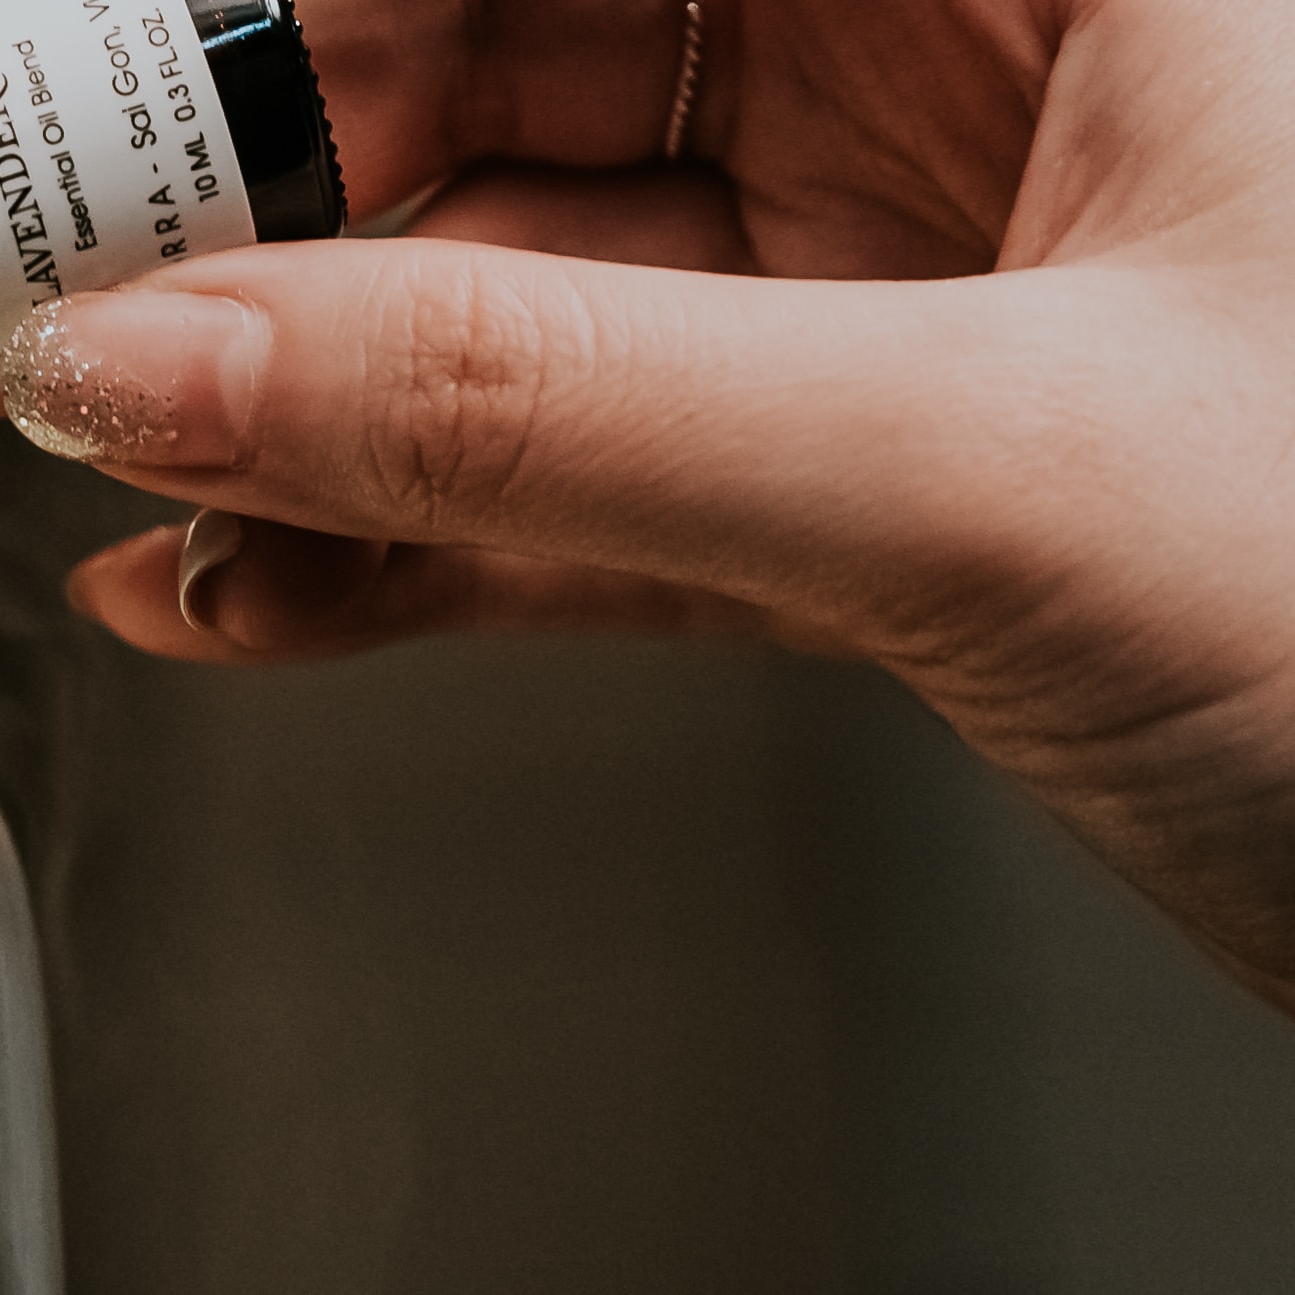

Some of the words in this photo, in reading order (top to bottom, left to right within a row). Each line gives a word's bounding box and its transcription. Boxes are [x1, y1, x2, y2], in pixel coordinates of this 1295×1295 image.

[12, 39, 53, 106] Blend
[104, 25, 139, 97] Gon,
[166, 83, 196, 122] 0.3
[37, 111, 65, 146] Oil
[121, 102, 157, 150] Sai
[183, 131, 212, 172] ML
[49, 150, 98, 252] Essential
[193, 174, 220, 203] 10
